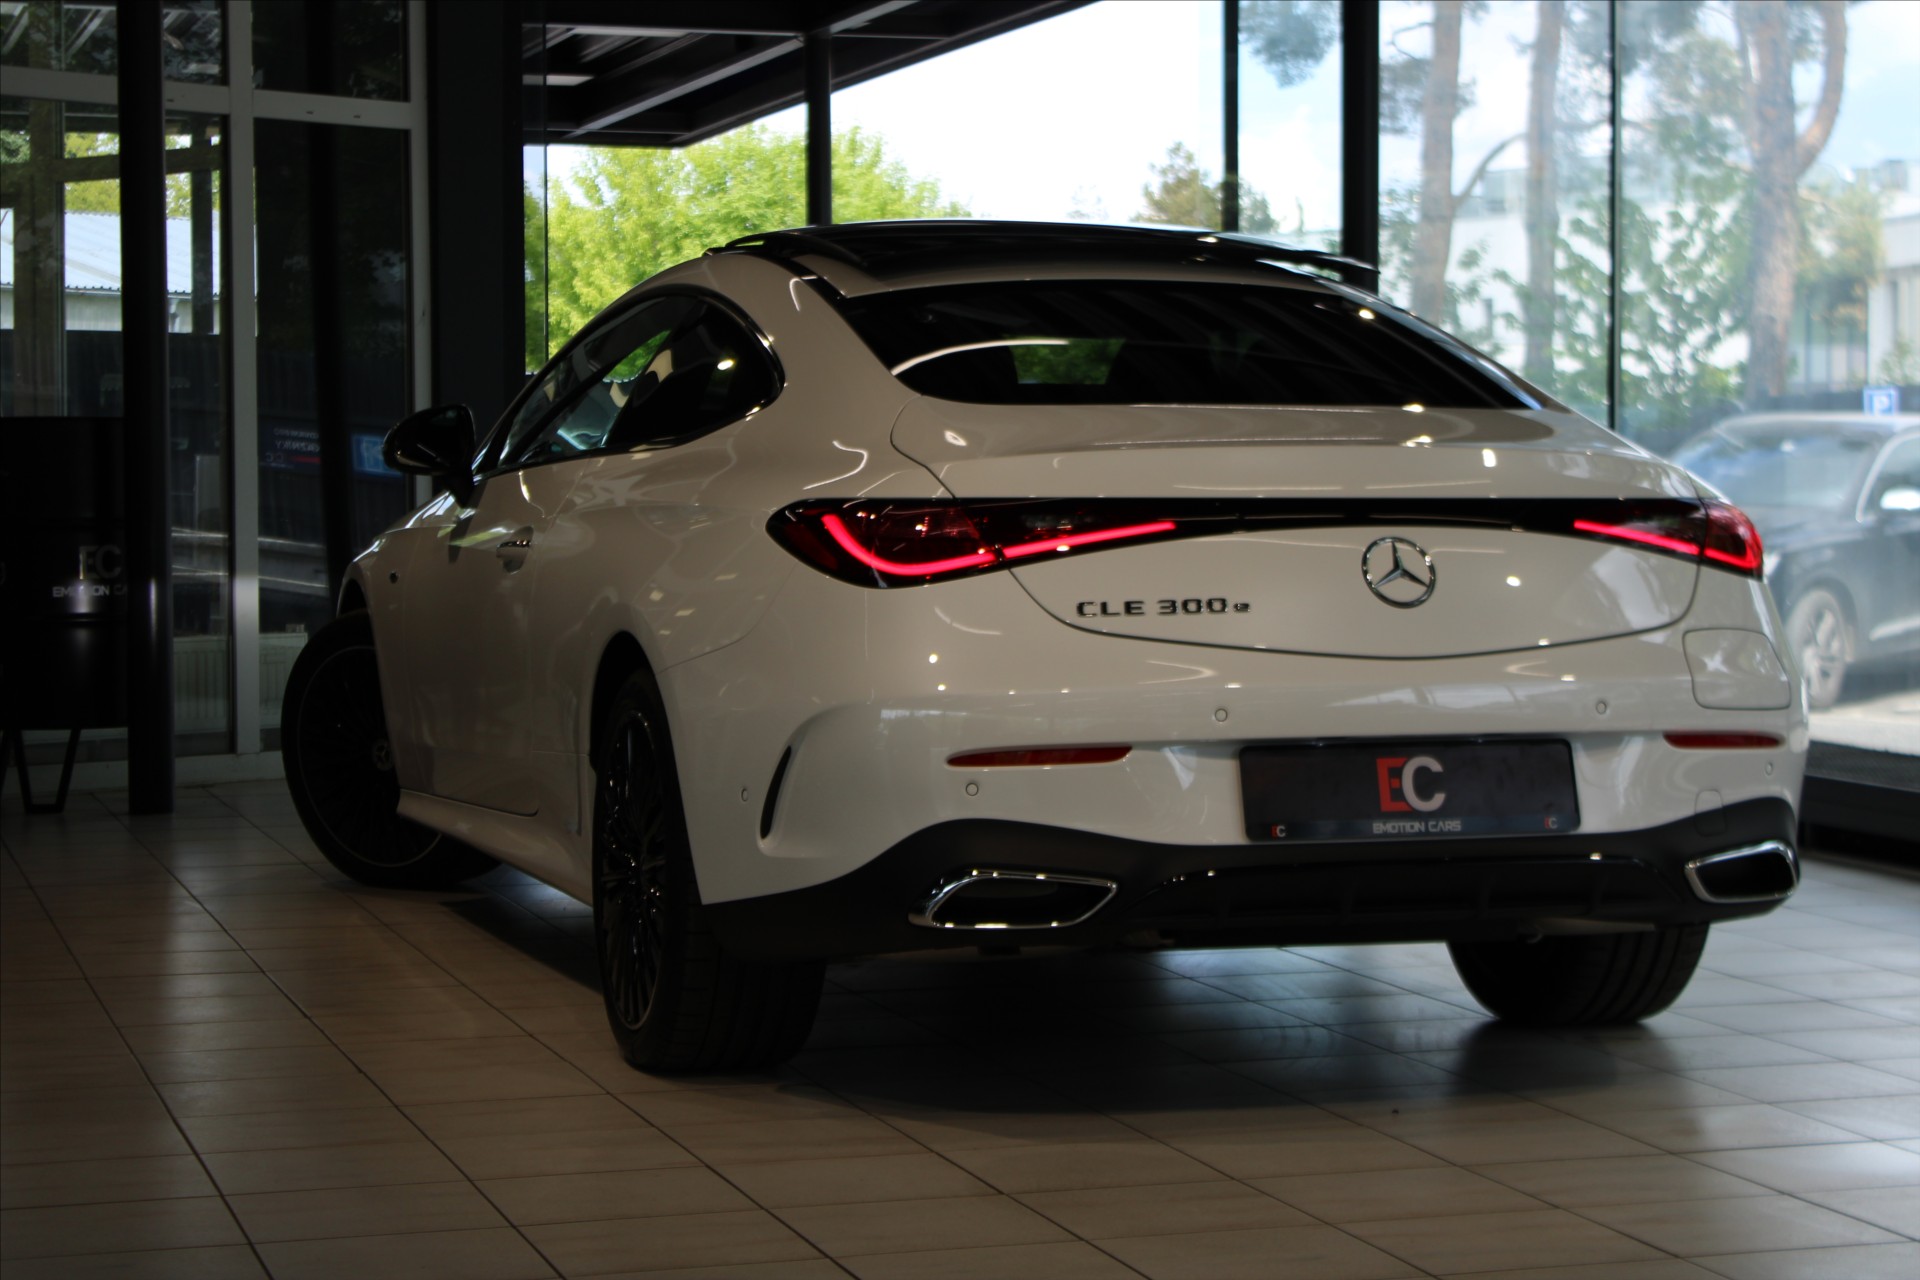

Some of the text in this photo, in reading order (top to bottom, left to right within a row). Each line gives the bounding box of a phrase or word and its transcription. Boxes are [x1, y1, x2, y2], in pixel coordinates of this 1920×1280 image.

[1077, 600, 1145, 617] CLE
[1376, 755, 1446, 813] EC
[1372, 819, 1462, 834] EMOTION CARS
